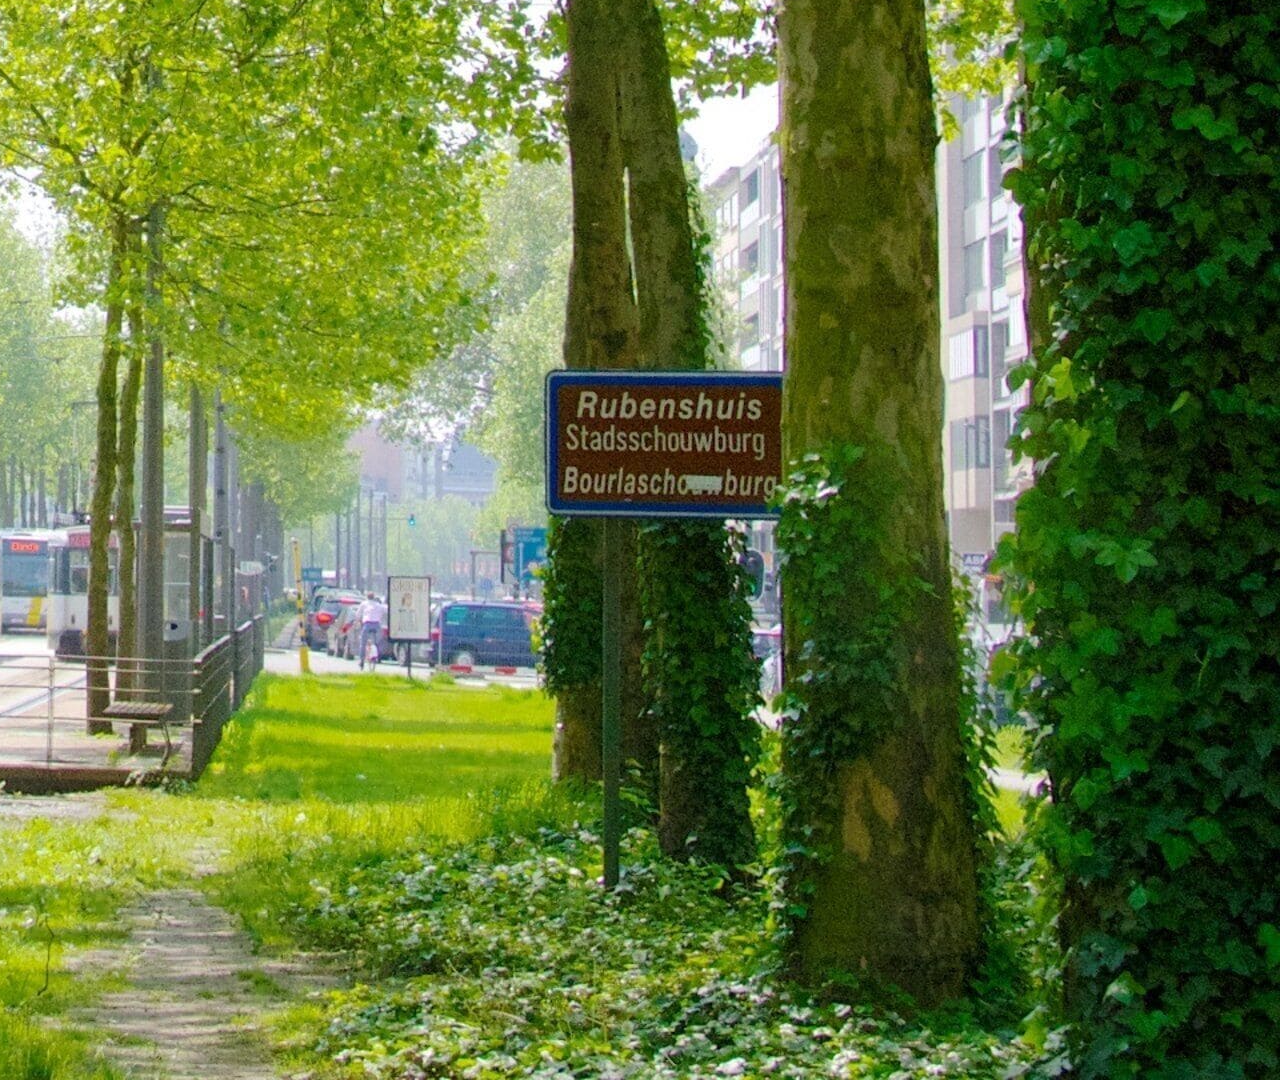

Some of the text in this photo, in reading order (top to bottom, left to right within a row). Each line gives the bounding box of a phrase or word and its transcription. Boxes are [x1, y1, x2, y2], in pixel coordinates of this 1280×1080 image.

[576, 390, 763, 420] Rubenshuis
[565, 423, 766, 461] Stadsschouwburg
[563, 466, 777, 500] Bourlaschoburg
